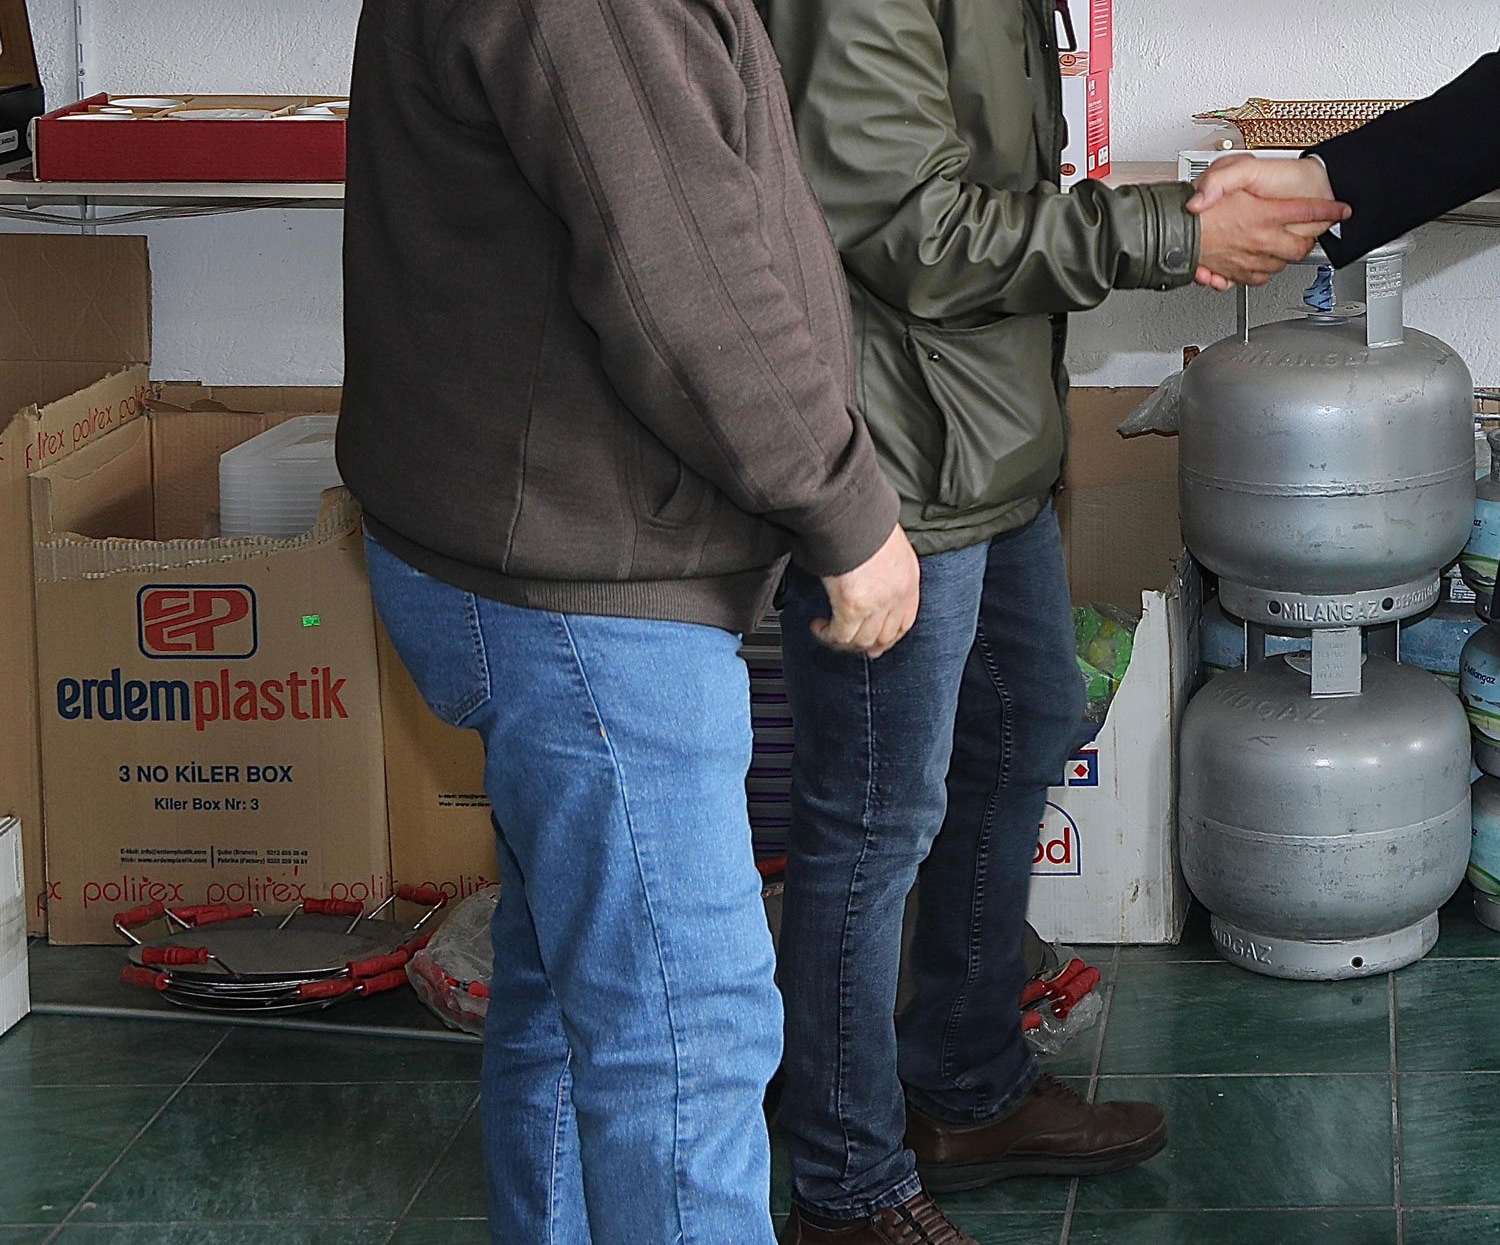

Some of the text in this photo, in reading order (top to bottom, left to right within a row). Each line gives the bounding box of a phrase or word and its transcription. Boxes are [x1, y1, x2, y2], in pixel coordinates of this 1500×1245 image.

[56, 666, 349, 732] erdemplastik
[118, 760, 294, 784] 3 NO KİLER BOX
[154, 797, 260, 812] Kiler Box Nr: 3
